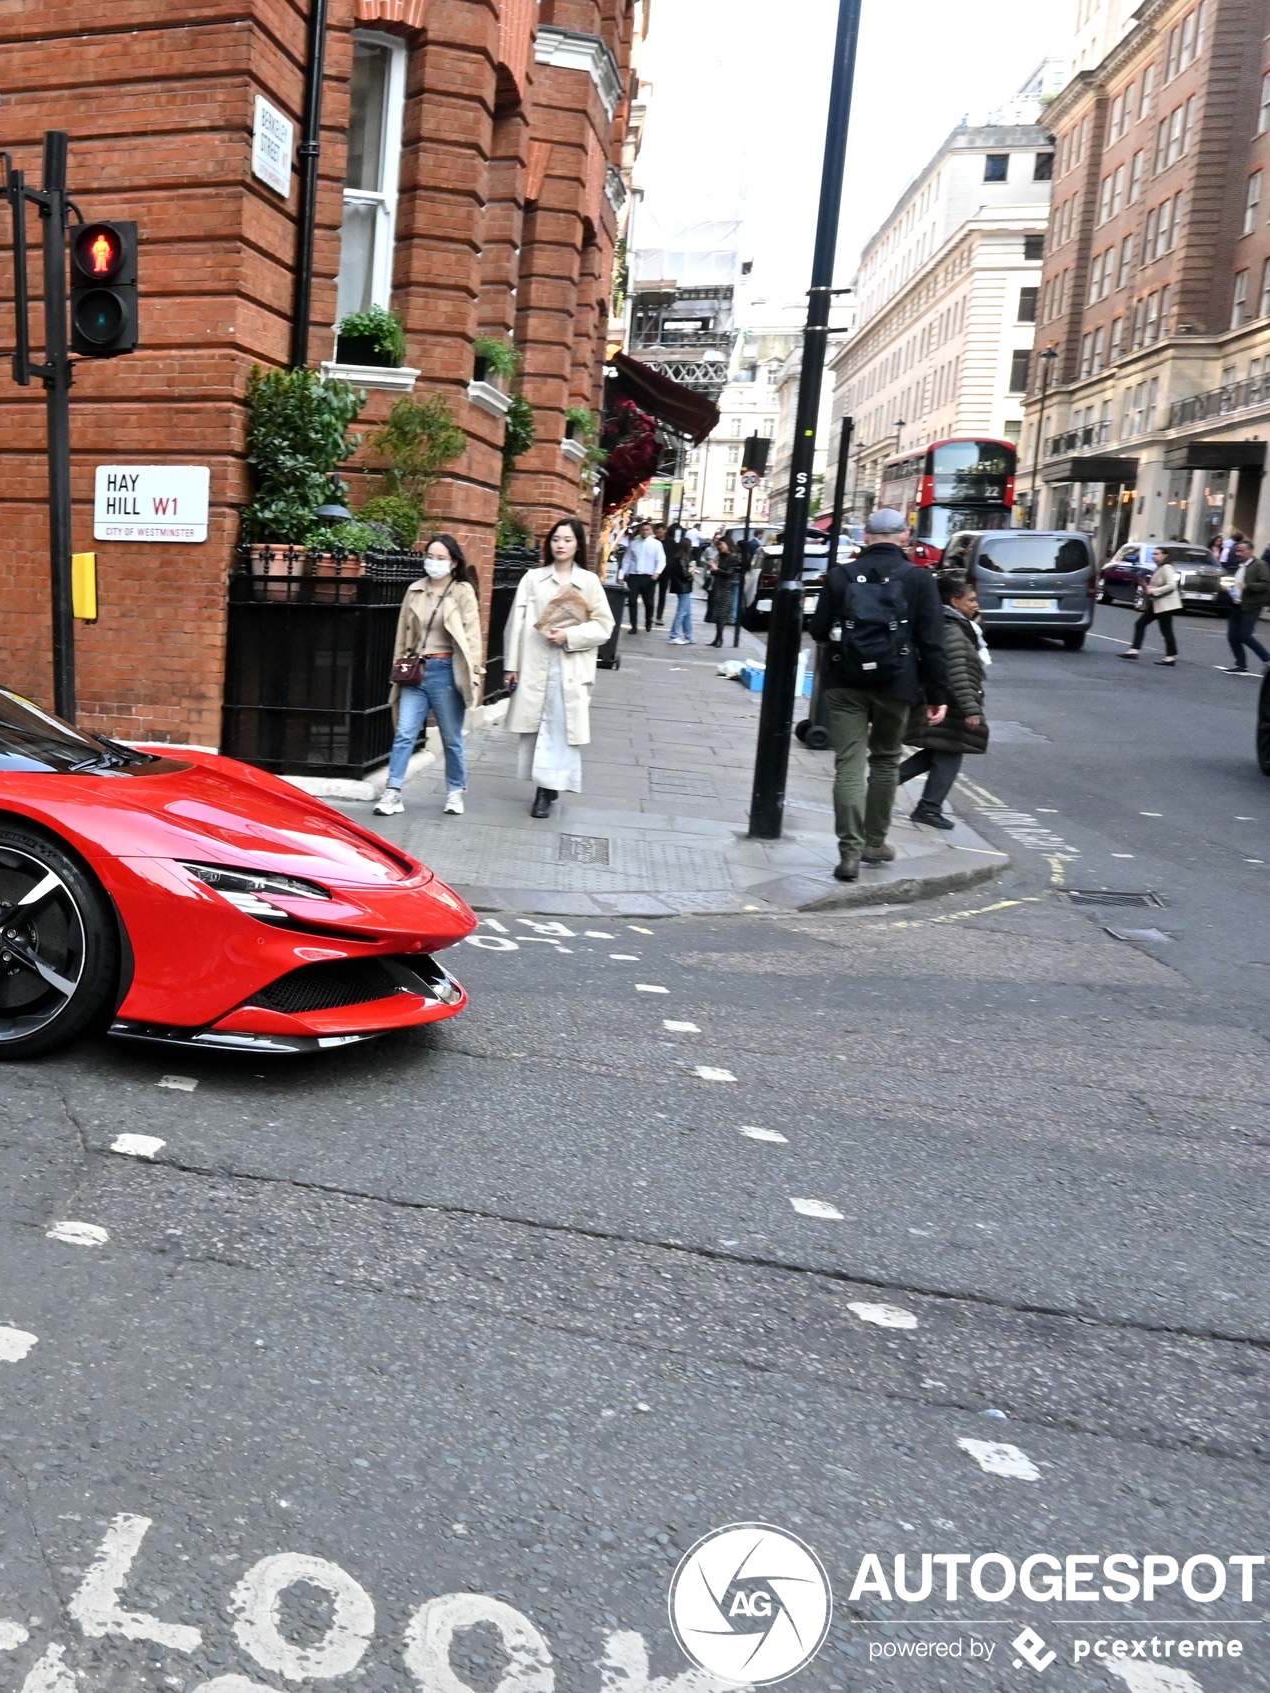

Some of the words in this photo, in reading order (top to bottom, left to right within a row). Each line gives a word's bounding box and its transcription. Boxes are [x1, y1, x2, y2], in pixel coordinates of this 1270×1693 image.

[261, 132, 280, 163] STREET
[107, 474, 140, 492] HAY
[984, 486, 1000, 497] 22
[106, 497, 141, 515] HILL
[153, 497, 178, 516] W1
[105, 527, 123, 536] CITY
[124, 527, 134, 536] OF
[137, 528, 195, 537] WESTMINSTER
